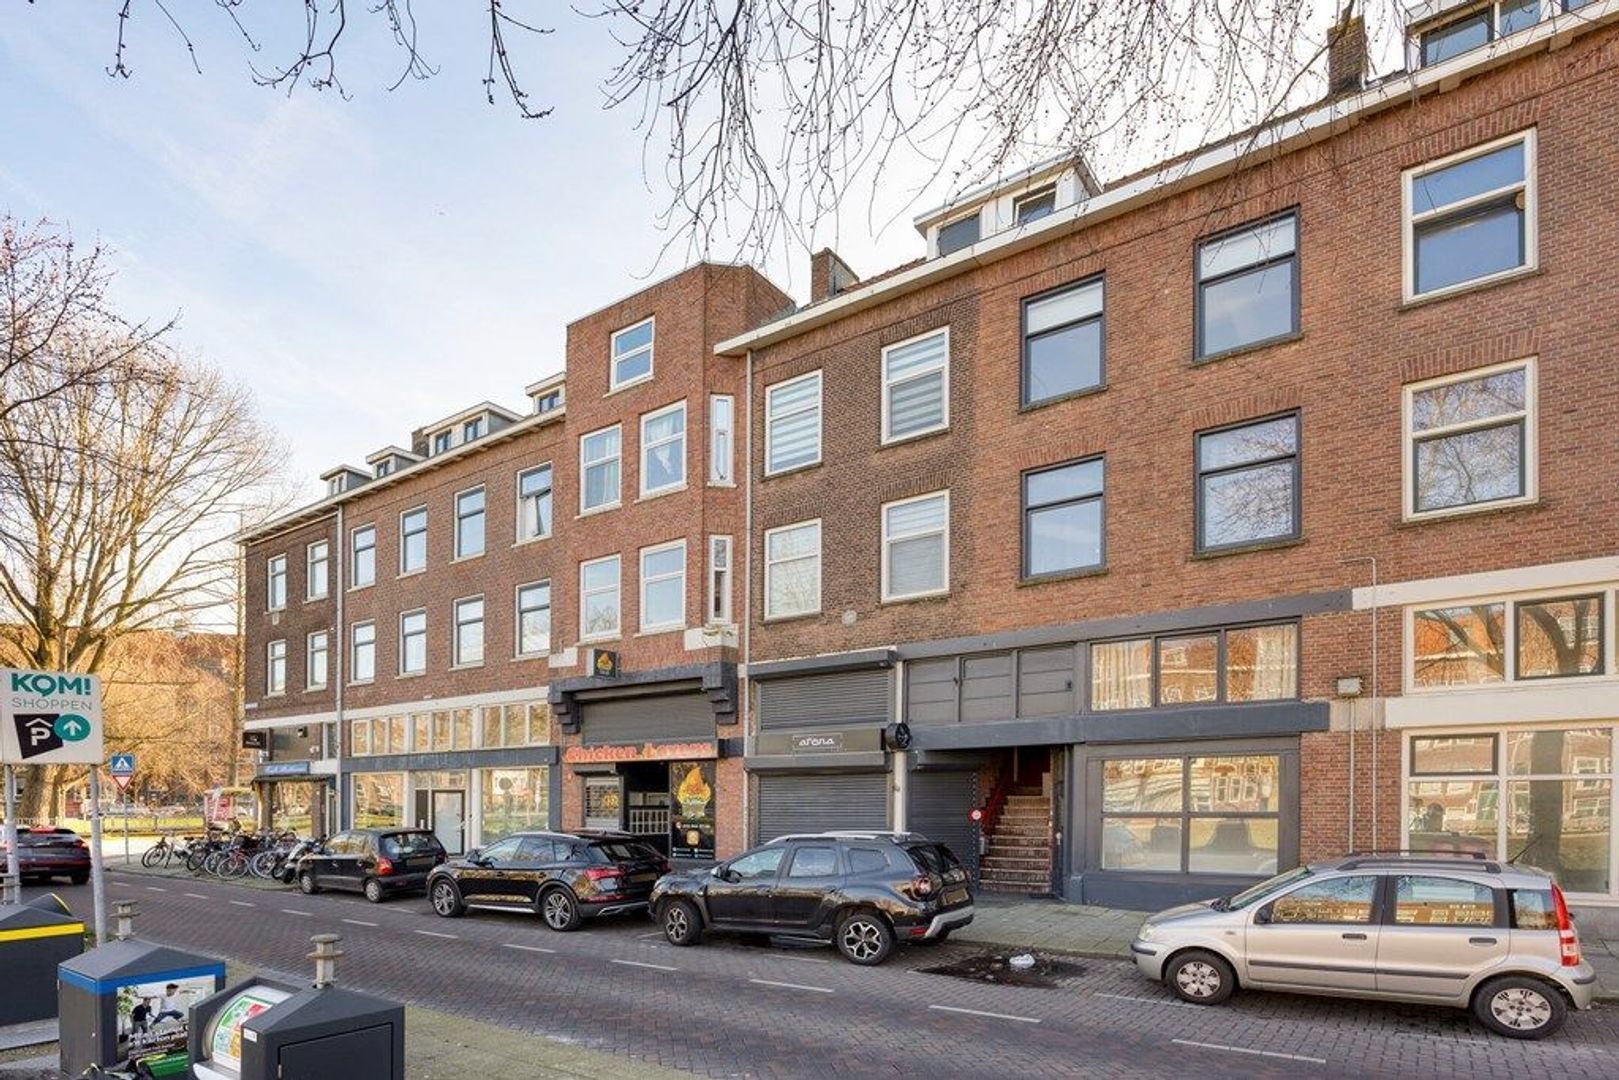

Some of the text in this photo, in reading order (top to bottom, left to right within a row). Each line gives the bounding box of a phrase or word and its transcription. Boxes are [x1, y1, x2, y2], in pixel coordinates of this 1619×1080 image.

[11, 673, 91, 696] KOM!
[12, 697, 92, 710] SHOPPEN
[30, 727, 51, 746] P
[799, 737, 835, 746] arena
[566, 745, 637, 762] Chicken
